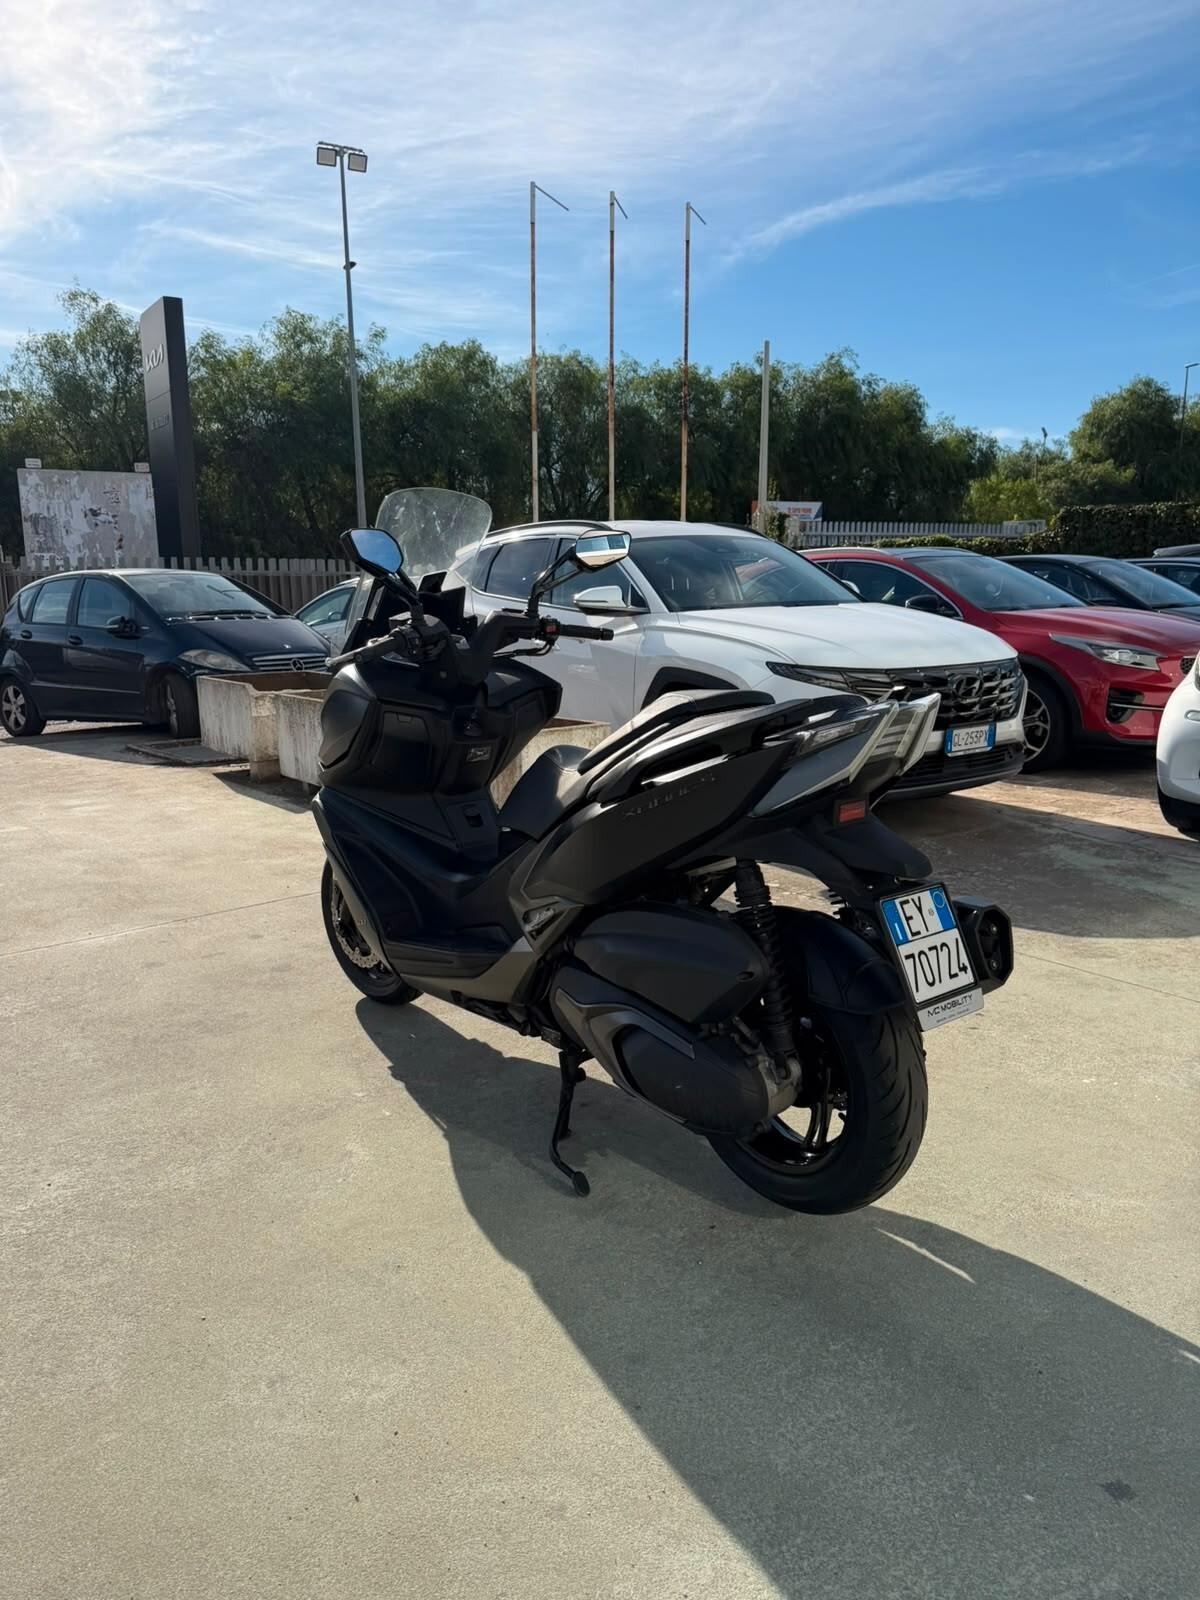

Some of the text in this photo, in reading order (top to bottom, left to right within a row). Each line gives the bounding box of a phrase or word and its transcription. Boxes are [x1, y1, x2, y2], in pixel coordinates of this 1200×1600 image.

[899, 896, 929, 938] EY
[904, 938, 969, 993] 70724
[940, 994, 973, 1011] MOBILITY
